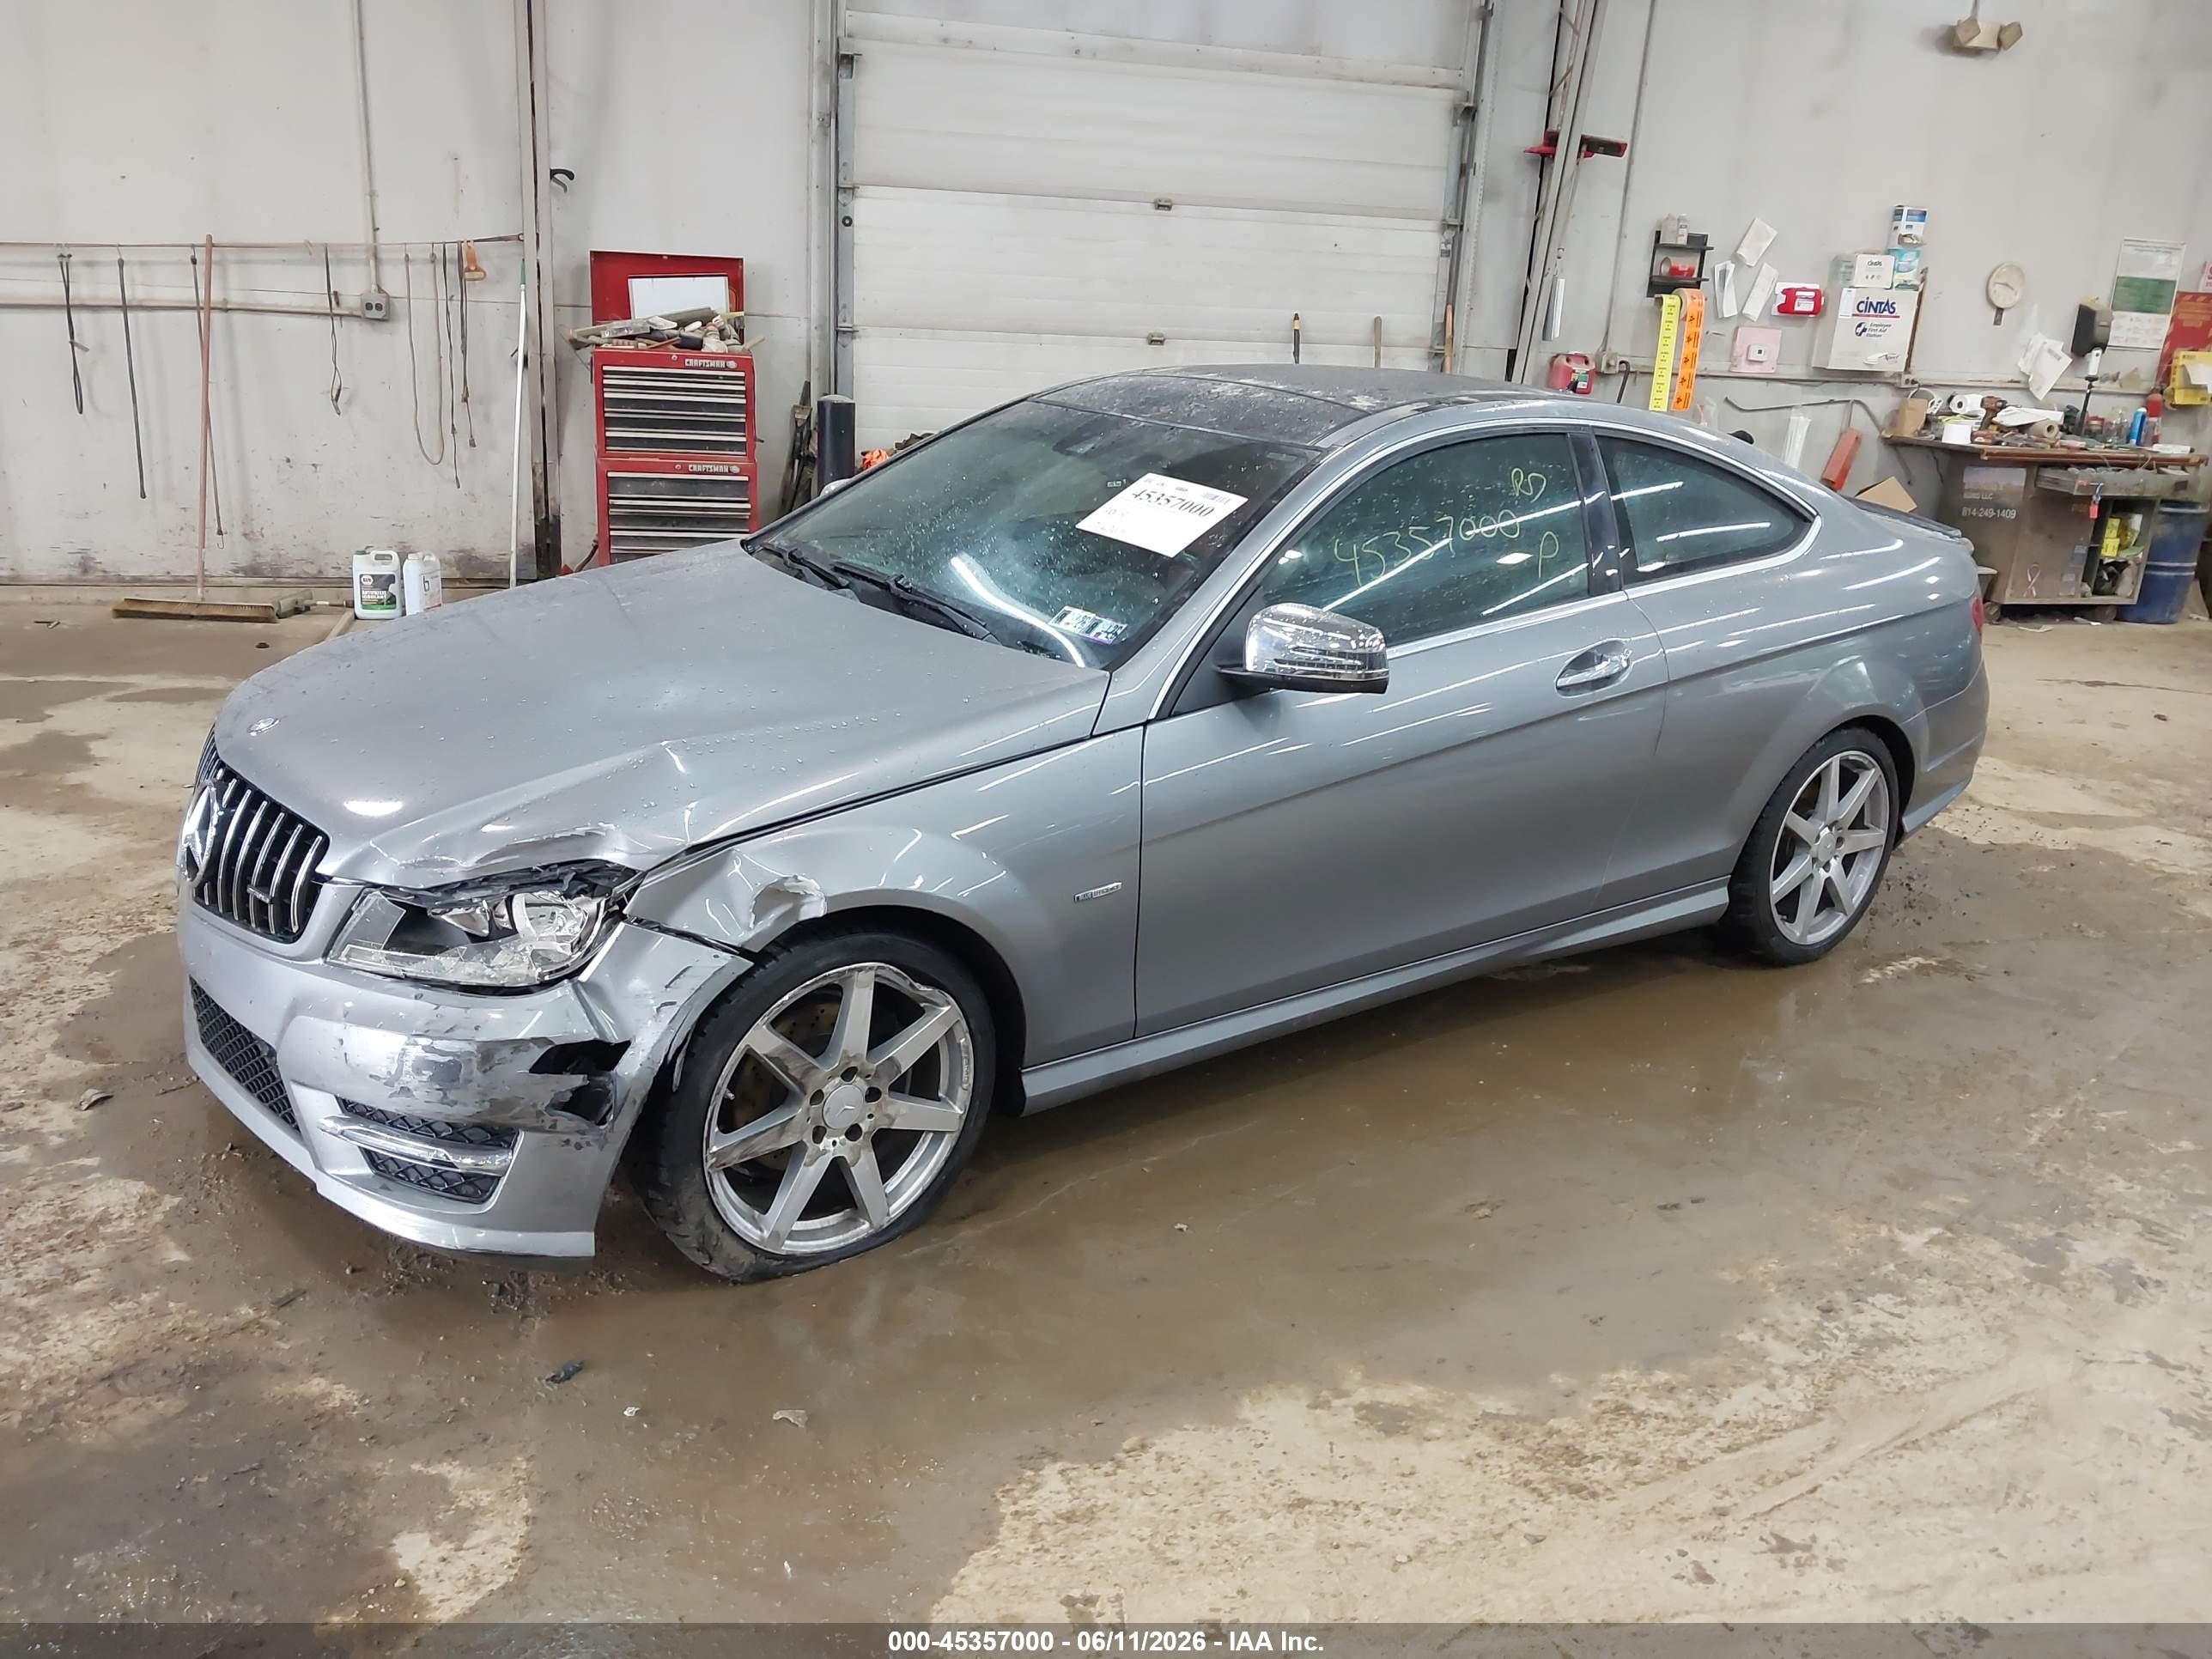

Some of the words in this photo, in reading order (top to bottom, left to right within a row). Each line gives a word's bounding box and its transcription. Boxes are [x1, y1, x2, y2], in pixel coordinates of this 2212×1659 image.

[1856, 296, 1897, 314] CINTAS
[684, 358, 726, 368] CRAFTSMAN
[688, 464, 729, 473] CRAFTSMAN
[1133, 489, 1215, 517] 45357000
[1334, 509, 1520, 586] 45357000
